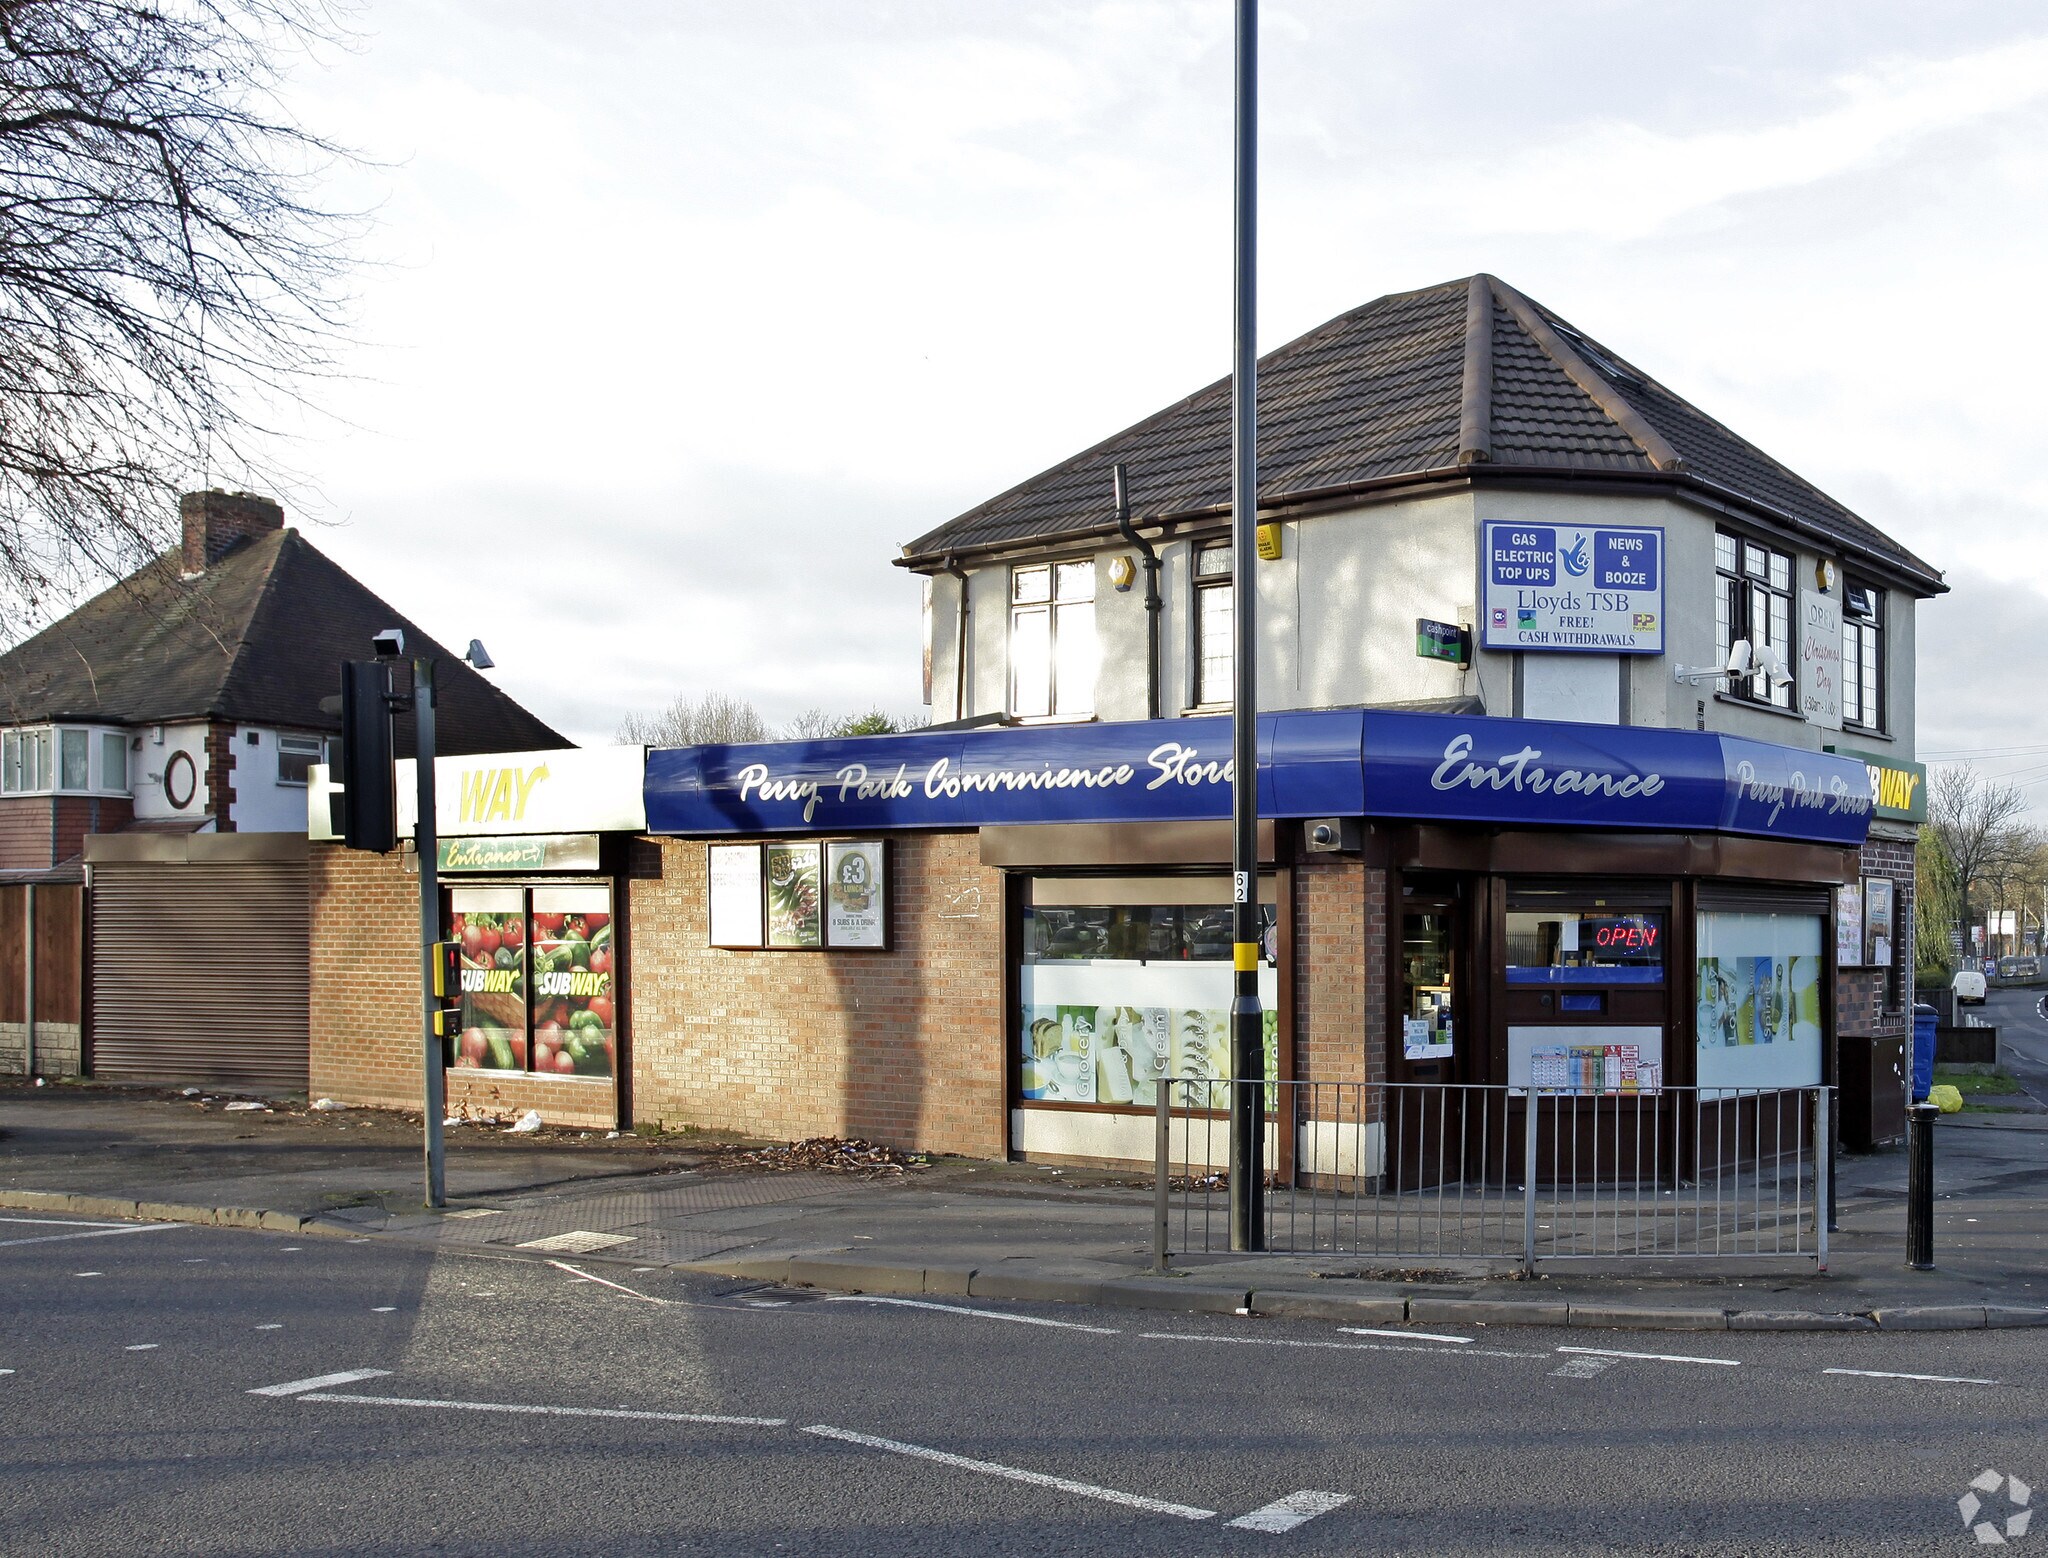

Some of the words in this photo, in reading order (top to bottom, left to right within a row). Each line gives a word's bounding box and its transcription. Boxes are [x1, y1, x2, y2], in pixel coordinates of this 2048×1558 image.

[1512, 533, 1537, 546] GAS
[1609, 538, 1643, 551] NEWS
[1495, 550, 1554, 564] ELECTRIC
[1621, 555, 1630, 567] &
[1499, 567, 1523, 579] TOP
[1526, 567, 1550, 580] UPS
[1605, 572, 1646, 585] BOOZE
[1517, 590, 1581, 615] Lloyds
[1586, 592, 1630, 612] TSB
[1559, 616, 1594, 628] FREE!
[1810, 604, 1835, 630] OPEN
[1518, 631, 1549, 643] CASH
[1553, 632, 1636, 646] WITHDRAWALS
[1804, 636, 1840, 662] Christmas
[1816, 665, 1832, 695] Day
[1431, 733, 1664, 798] Entrance
[737, 762, 823, 823] Perry
[836, 762, 913, 803] Park
[1146, 742, 1259, 790] Store
[1736, 760, 1784, 828] Perry
[1790, 771, 1825, 809] Park
[1829, 775, 1870, 815] Stores
[446, 840, 521, 868] Entrance
[842, 856, 865, 884] £3
[1597, 927, 1657, 946] OPEN
[538, 971, 611, 996] SUBWAY
[1709, 967, 1717, 1043] Grocery
[1763, 980, 1772, 1039] Spirits
[1153, 1014, 1166, 1071] Cream
[1195, 1014, 1204, 1049] Cakes
[1075, 1018, 1093, 1097] Grocery
[1195, 1054, 1204, 1062] &
